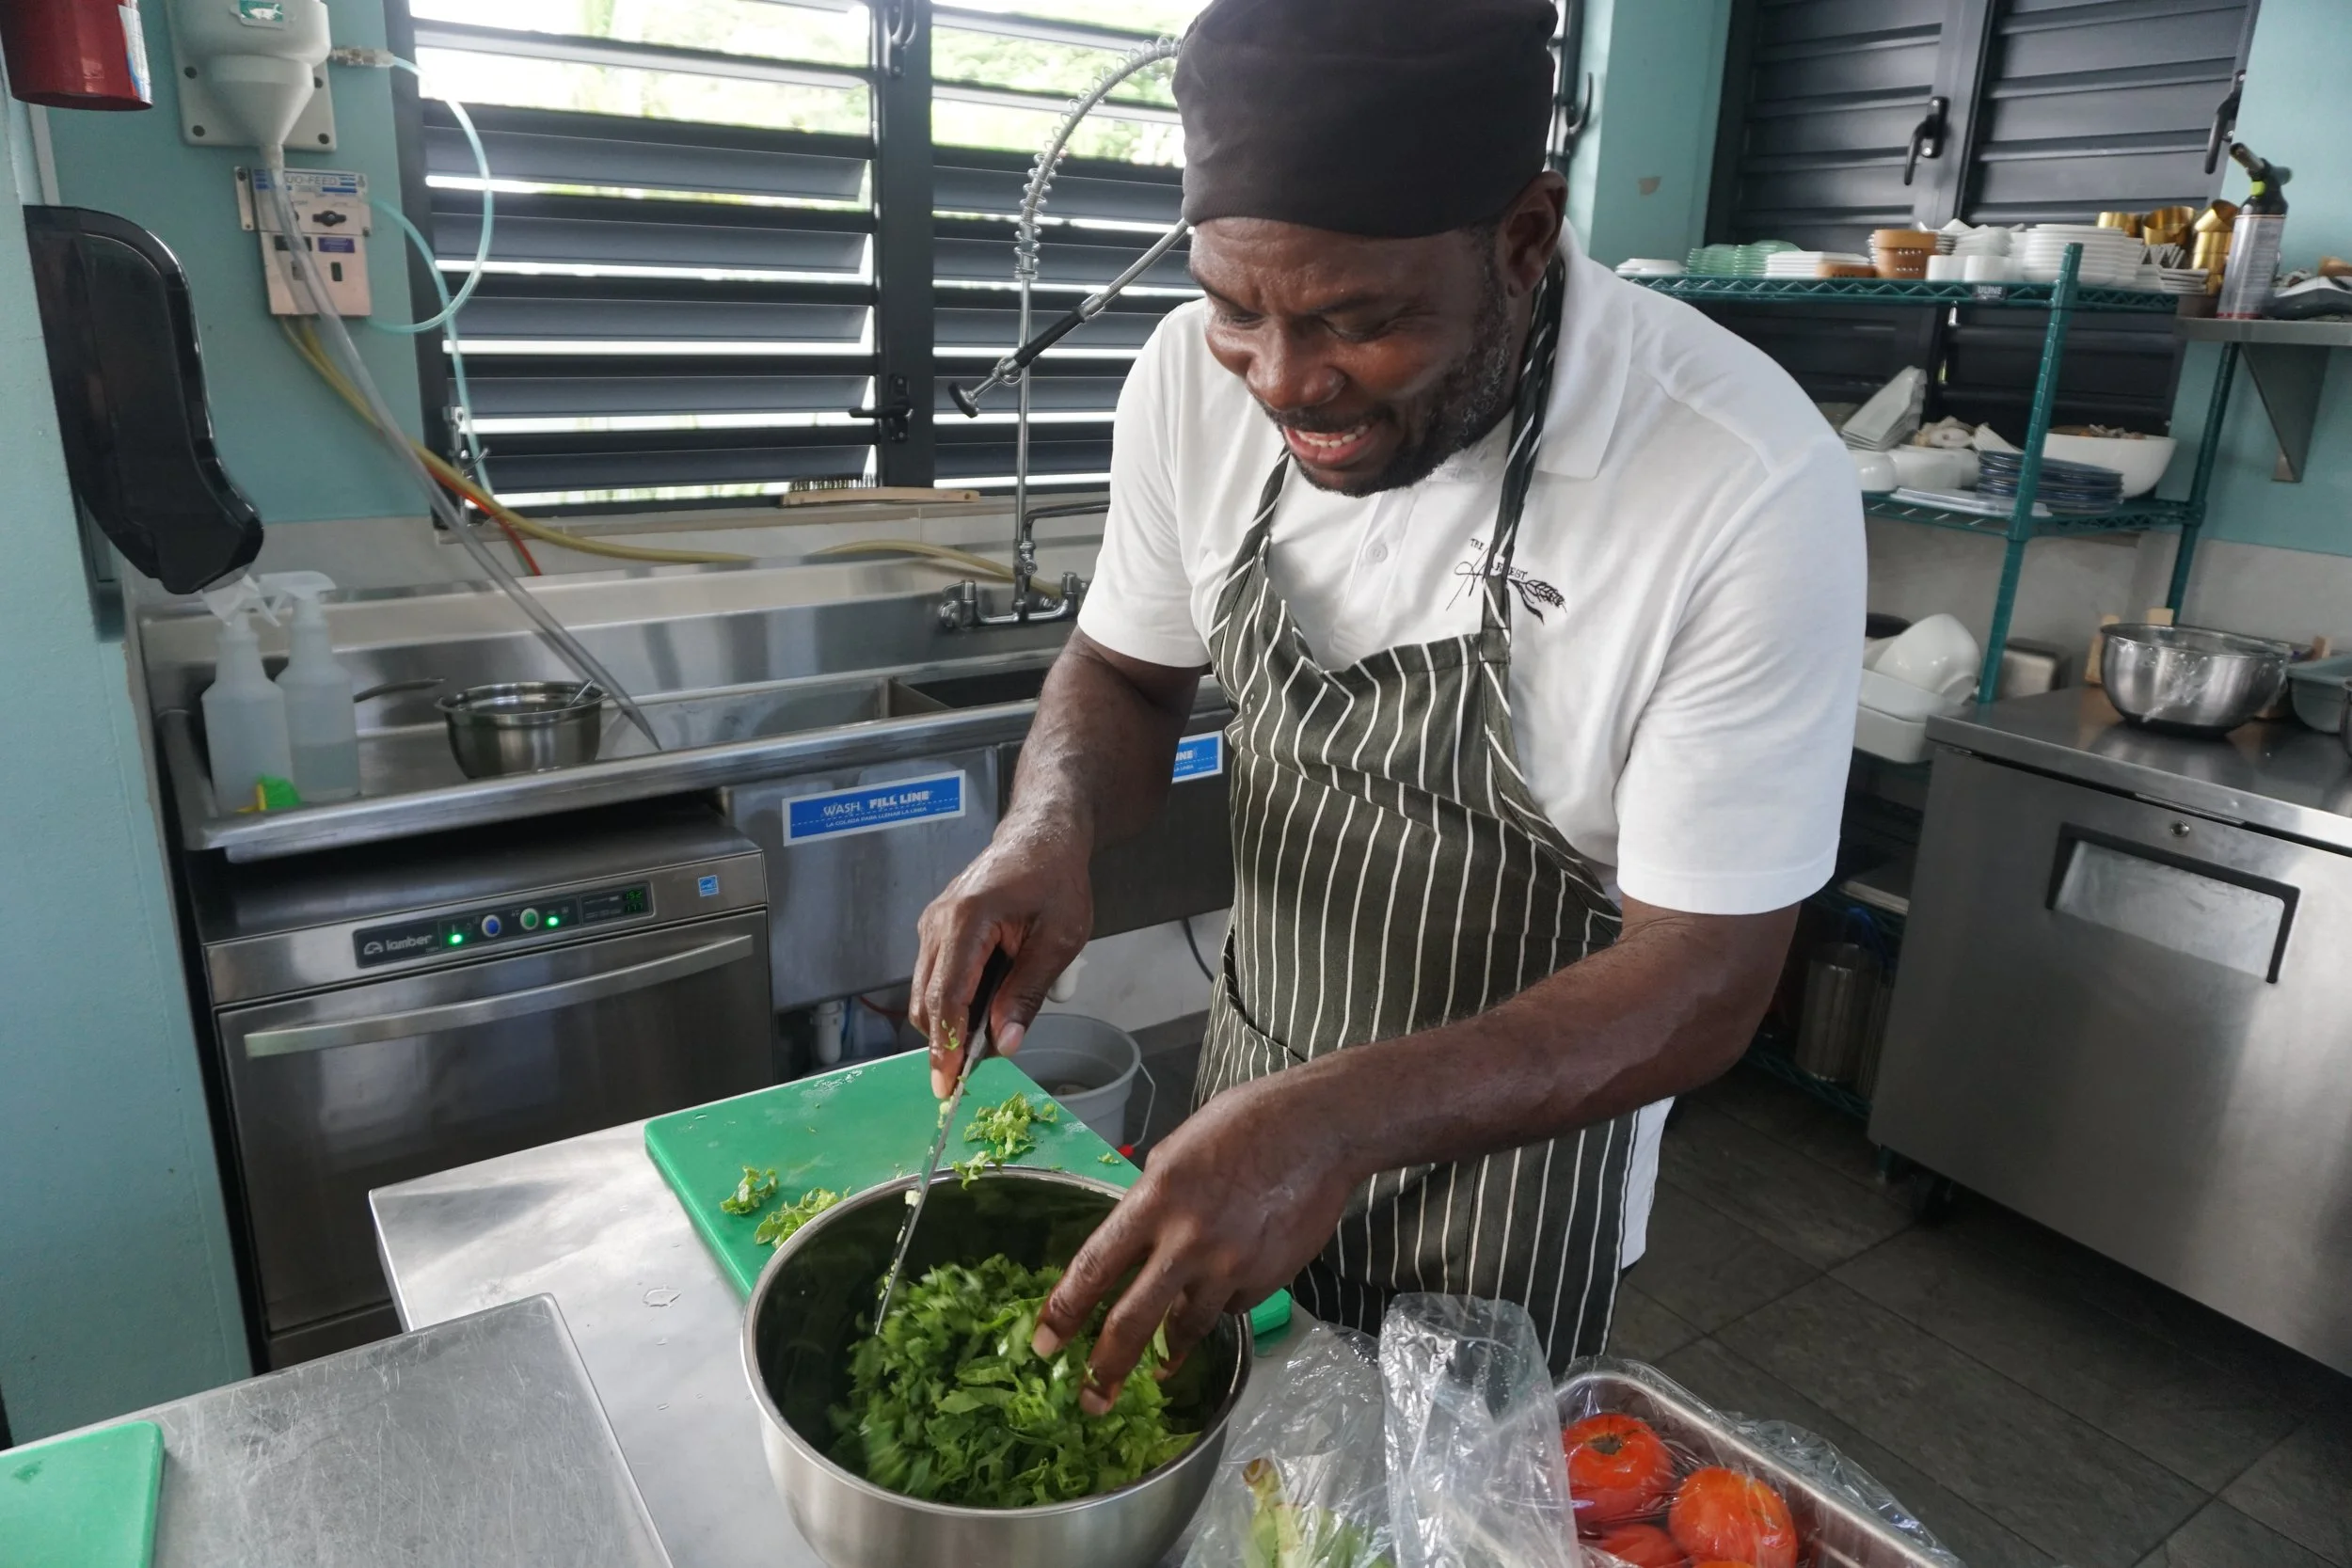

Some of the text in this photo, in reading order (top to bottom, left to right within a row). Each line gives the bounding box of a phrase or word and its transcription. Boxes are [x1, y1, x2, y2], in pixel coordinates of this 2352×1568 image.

[285, 175, 337, 185] UO-FEED
[1978, 285, 2002, 294] ULINE
[1470, 538, 1485, 550] THE
[1175, 750, 1194, 761] INE
[823, 790, 930, 816] WASH FILL LINE
[387, 935, 433, 952] lamber
